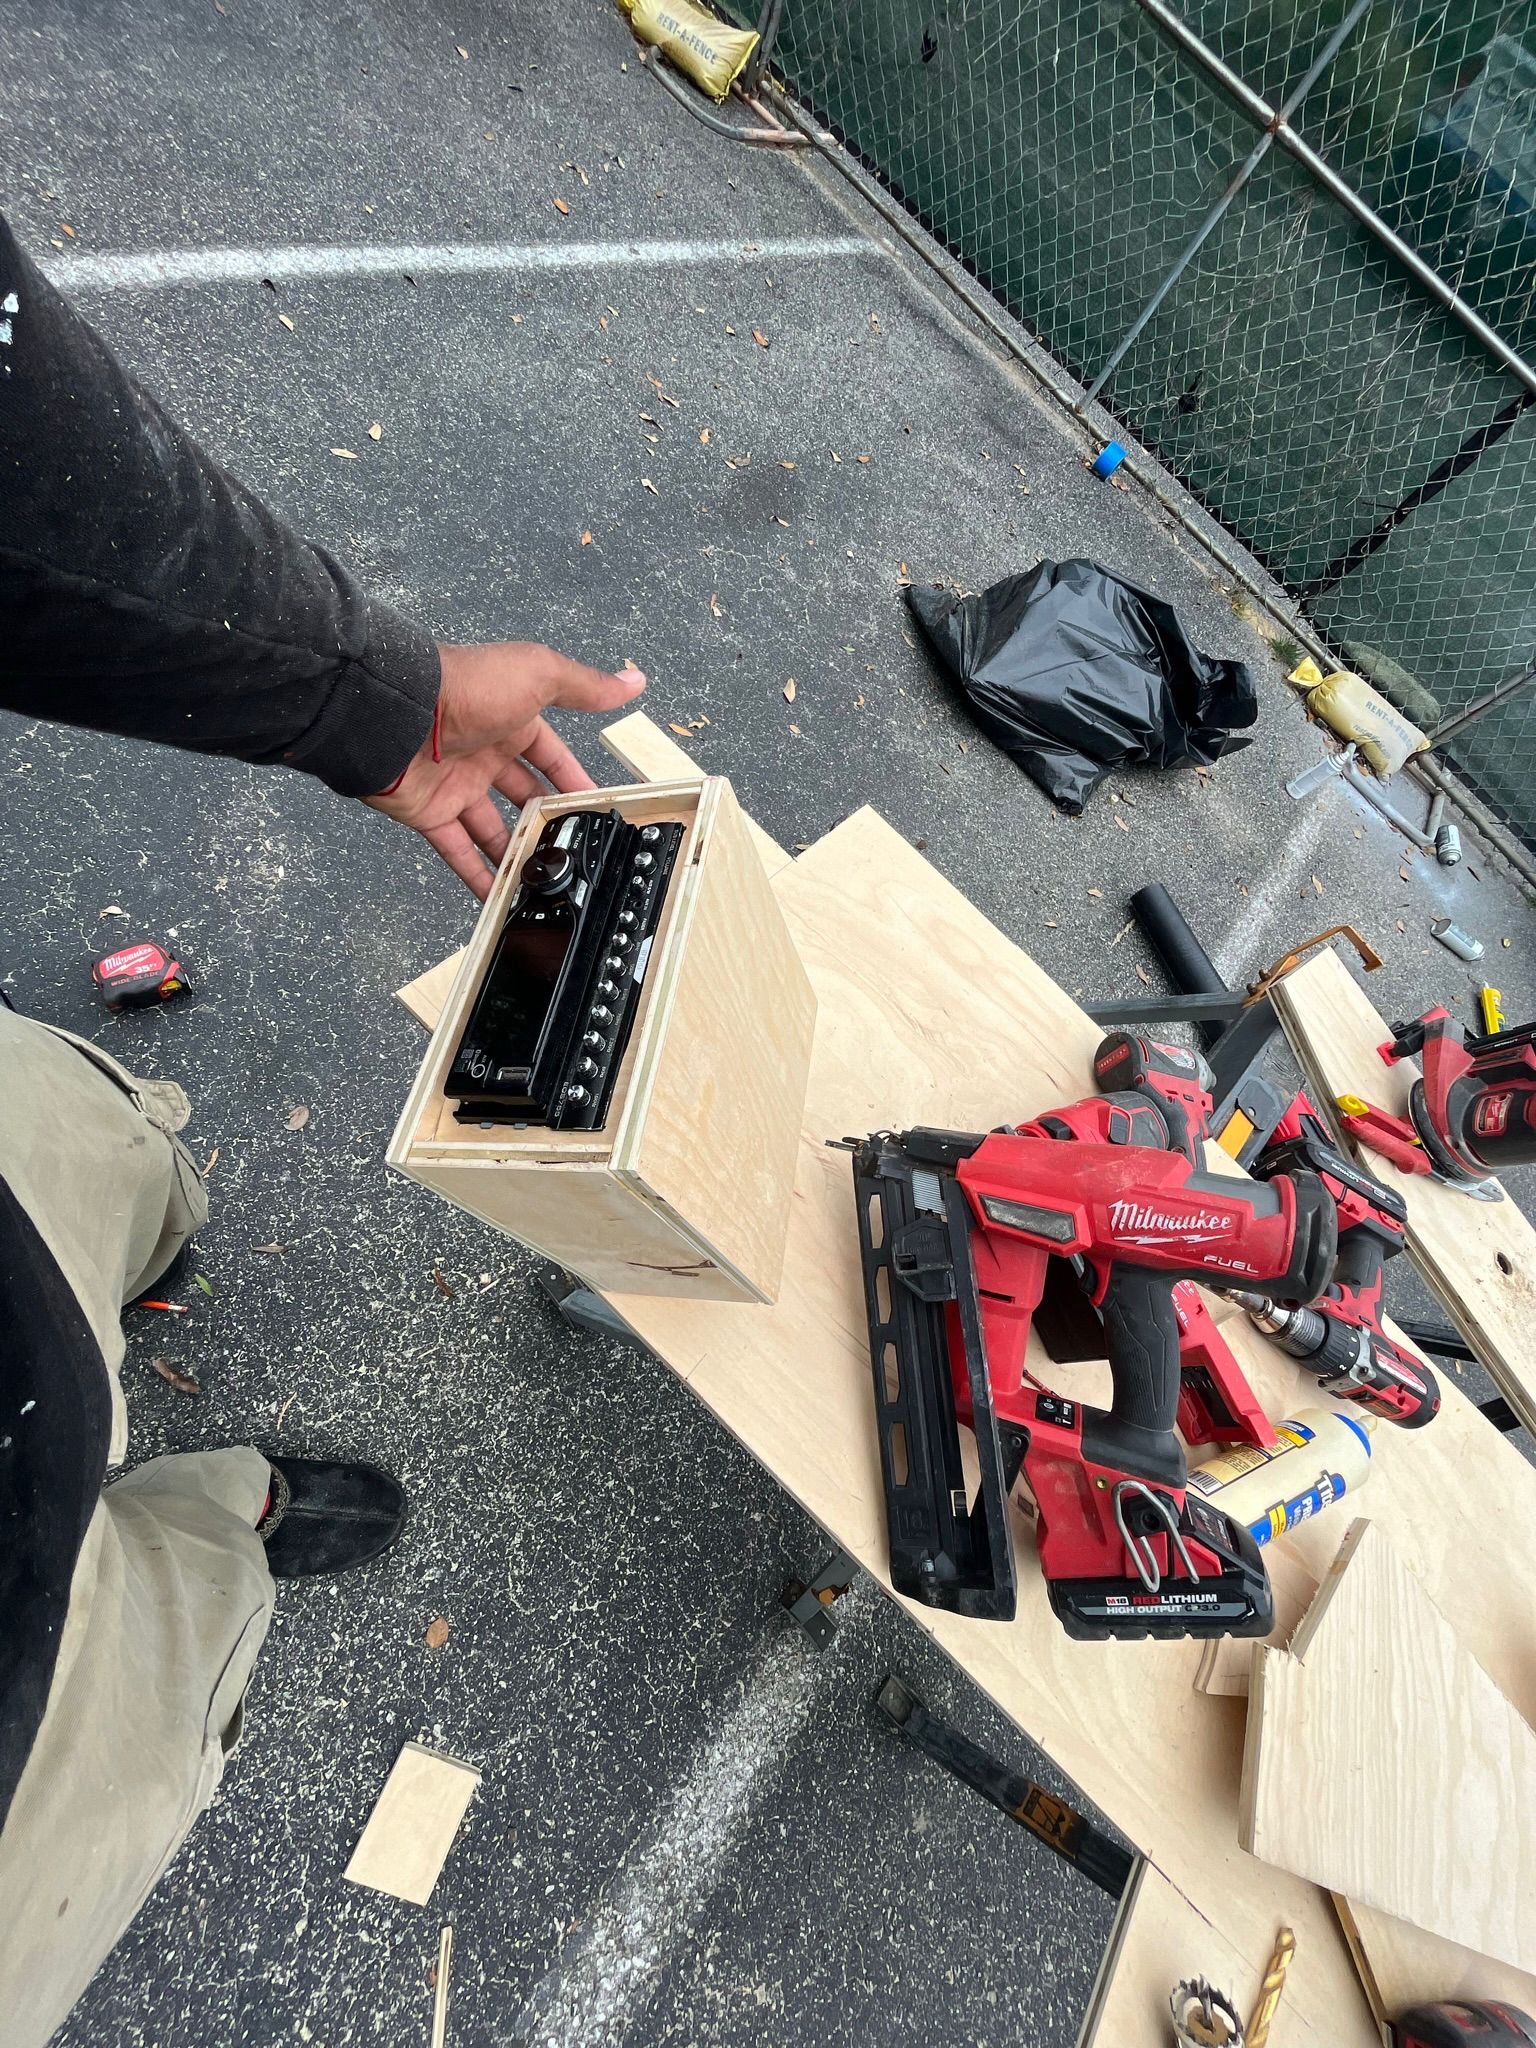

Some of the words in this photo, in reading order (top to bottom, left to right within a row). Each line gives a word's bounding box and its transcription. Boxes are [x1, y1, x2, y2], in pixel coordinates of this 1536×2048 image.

[656, 12, 720, 65] RENT-A-FENCE
[103, 947, 154, 971] Milwaukee
[1108, 1199, 1233, 1232] Milwaukee
[1203, 1254, 1259, 1274] FUEL
[1171, 1293, 1189, 1329] FUEL
[1106, 1597, 1128, 1605] M18
[1132, 1593, 1218, 1605] REDLITHIUM
[1106, 1605, 1135, 1615] HIGH
[1137, 1604, 1183, 1614] OUTPUT
